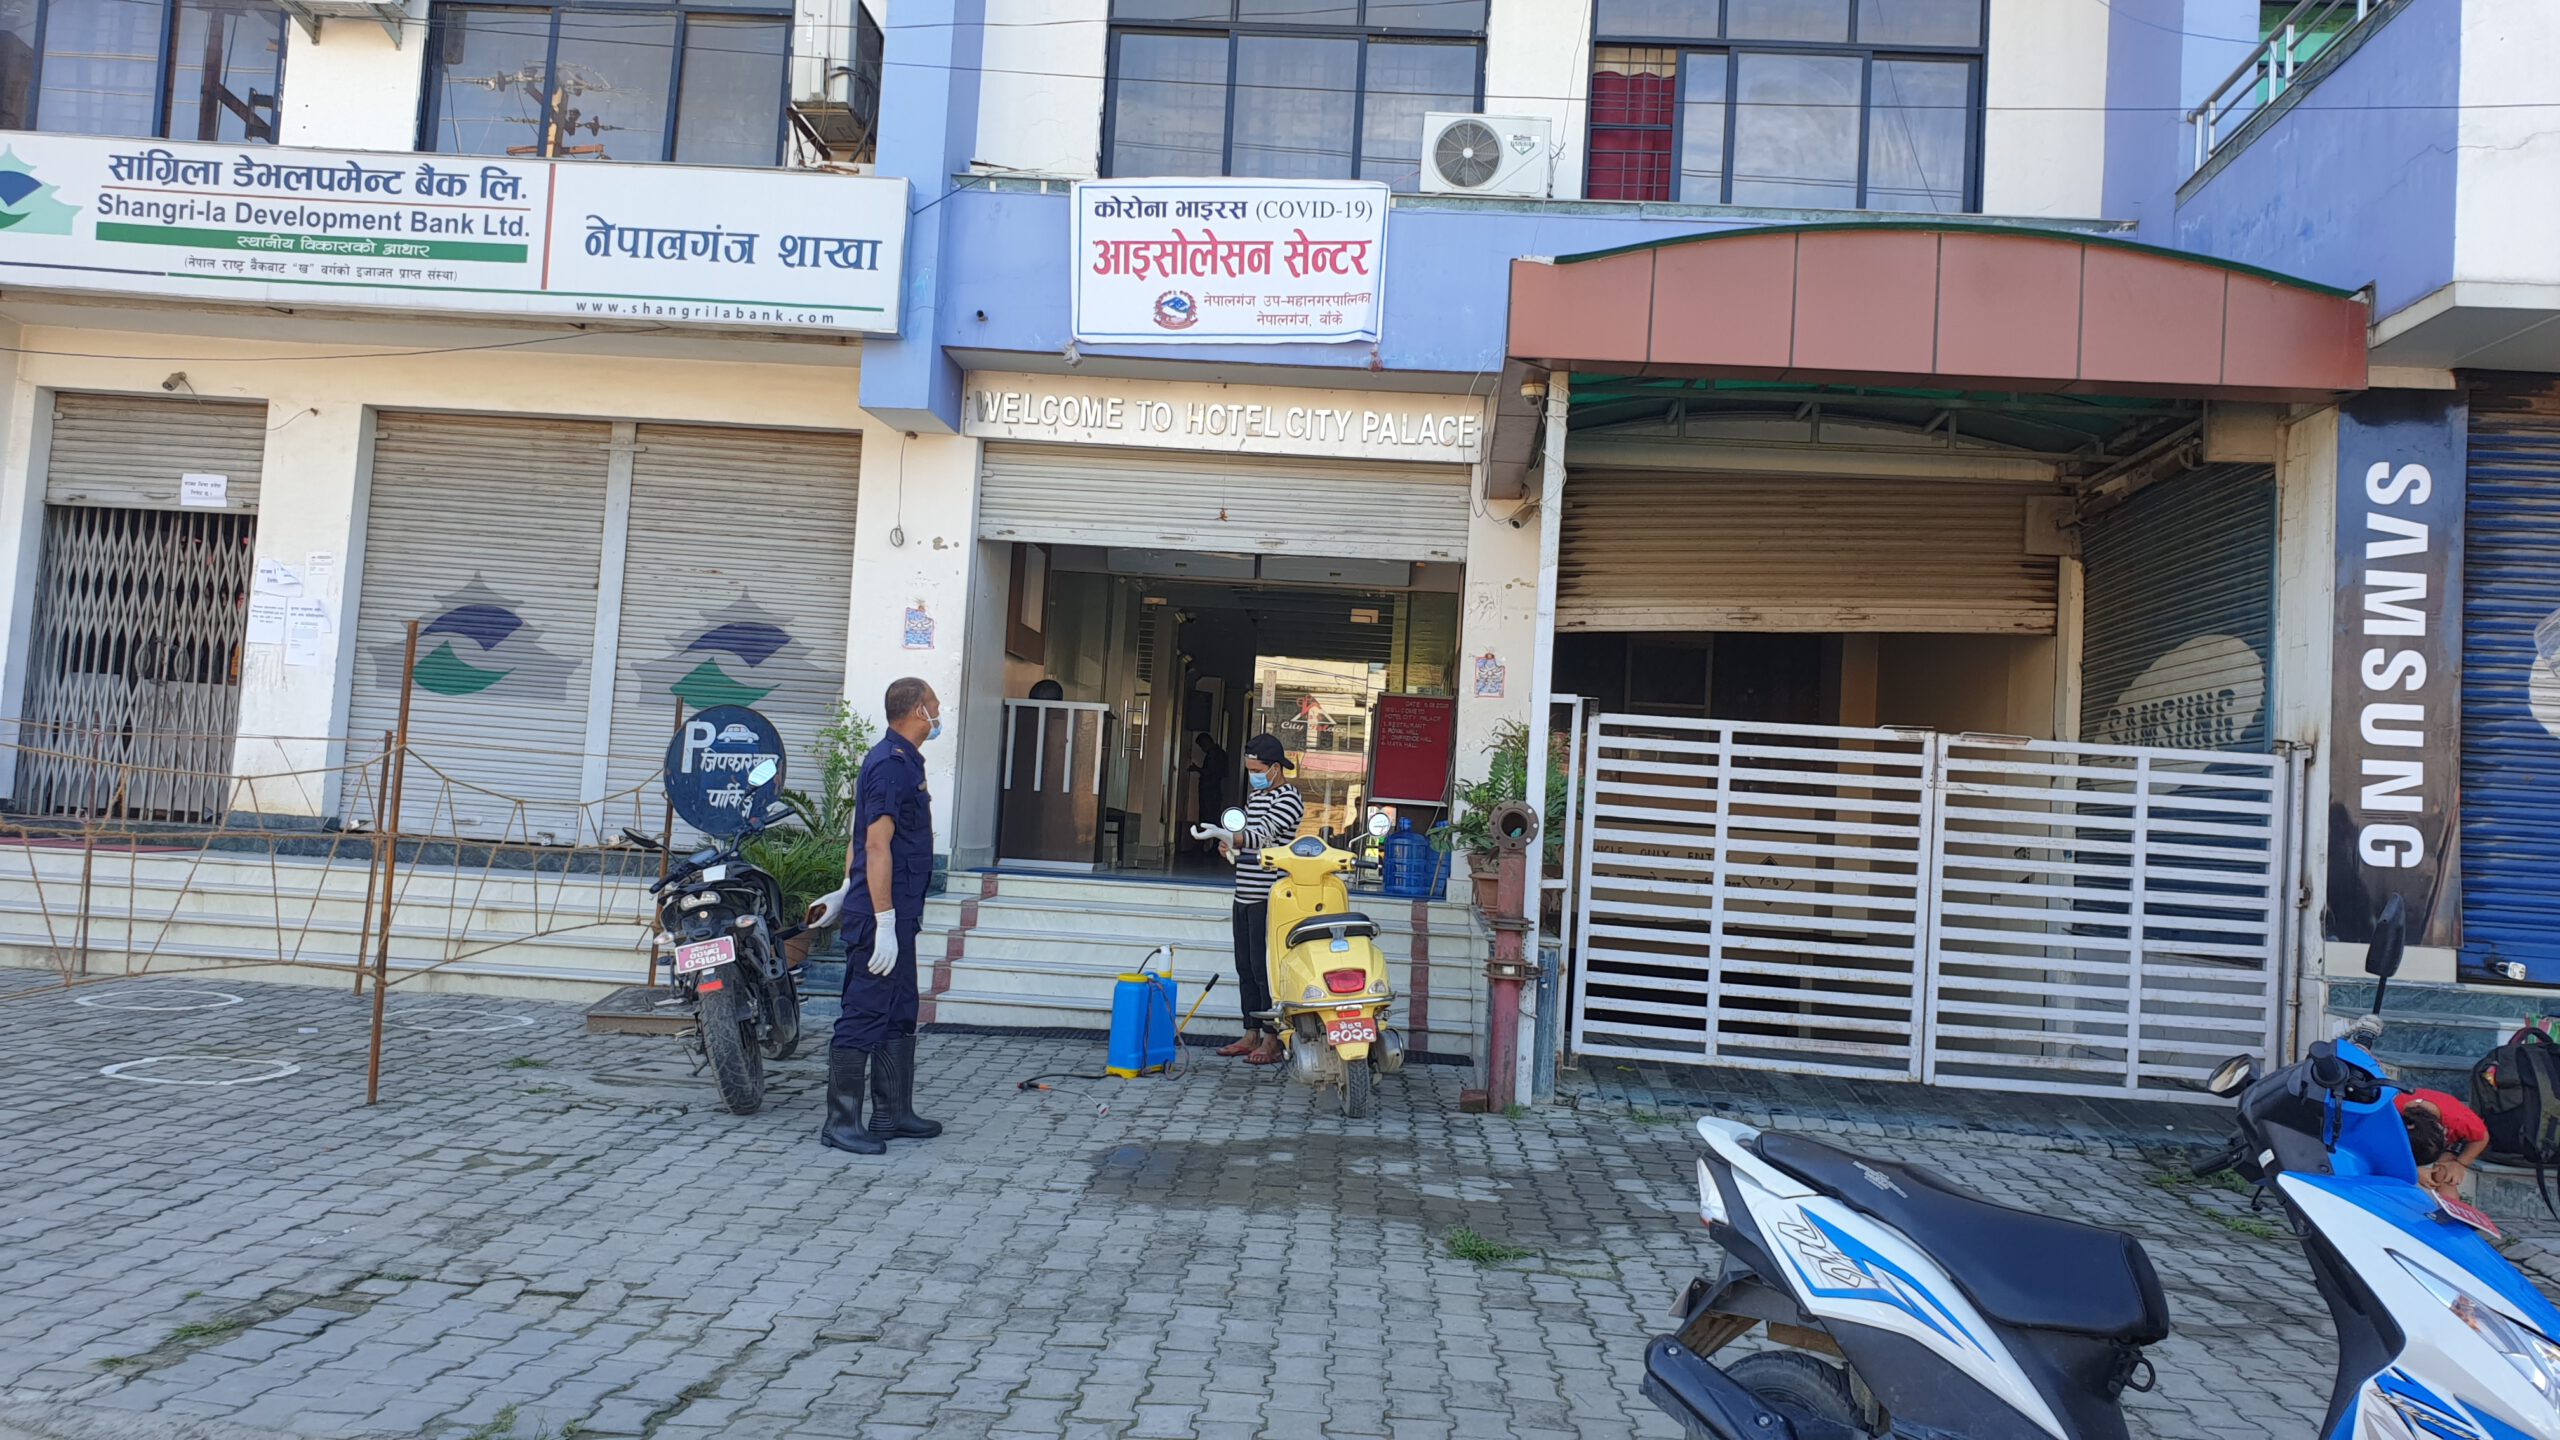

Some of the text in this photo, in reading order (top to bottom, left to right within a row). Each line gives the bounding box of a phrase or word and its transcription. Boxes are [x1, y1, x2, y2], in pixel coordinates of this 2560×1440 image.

[108, 148, 221, 187] सांग्रिला
[233, 154, 403, 195] डेभलपमेन्ट
[480, 166, 528, 201] लि.
[97, 192, 530, 237] Shangri-la Development Bank Ltd.
[1094, 195, 1373, 222] कोरोना भाइरस (COVID-19)
[237, 234, 430, 257] स्थानीय विकासको आधार
[585, 214, 883, 271] नेपालगंज शाखा
[1092, 228, 1373, 281] आइसोलेसन सेन्टर
[576, 301, 835, 324] www.shangrilabank.com
[1203, 292, 1372, 308] नेपालगंज उप-महानगरपालिका
[1257, 311, 1312, 327] नेपालगंज,
[975, 391, 1476, 448] WELCOME TO HOTEL CITY PALACE
[2357, 461, 2432, 869] SAMSUNG
[681, 719, 717, 773] P
